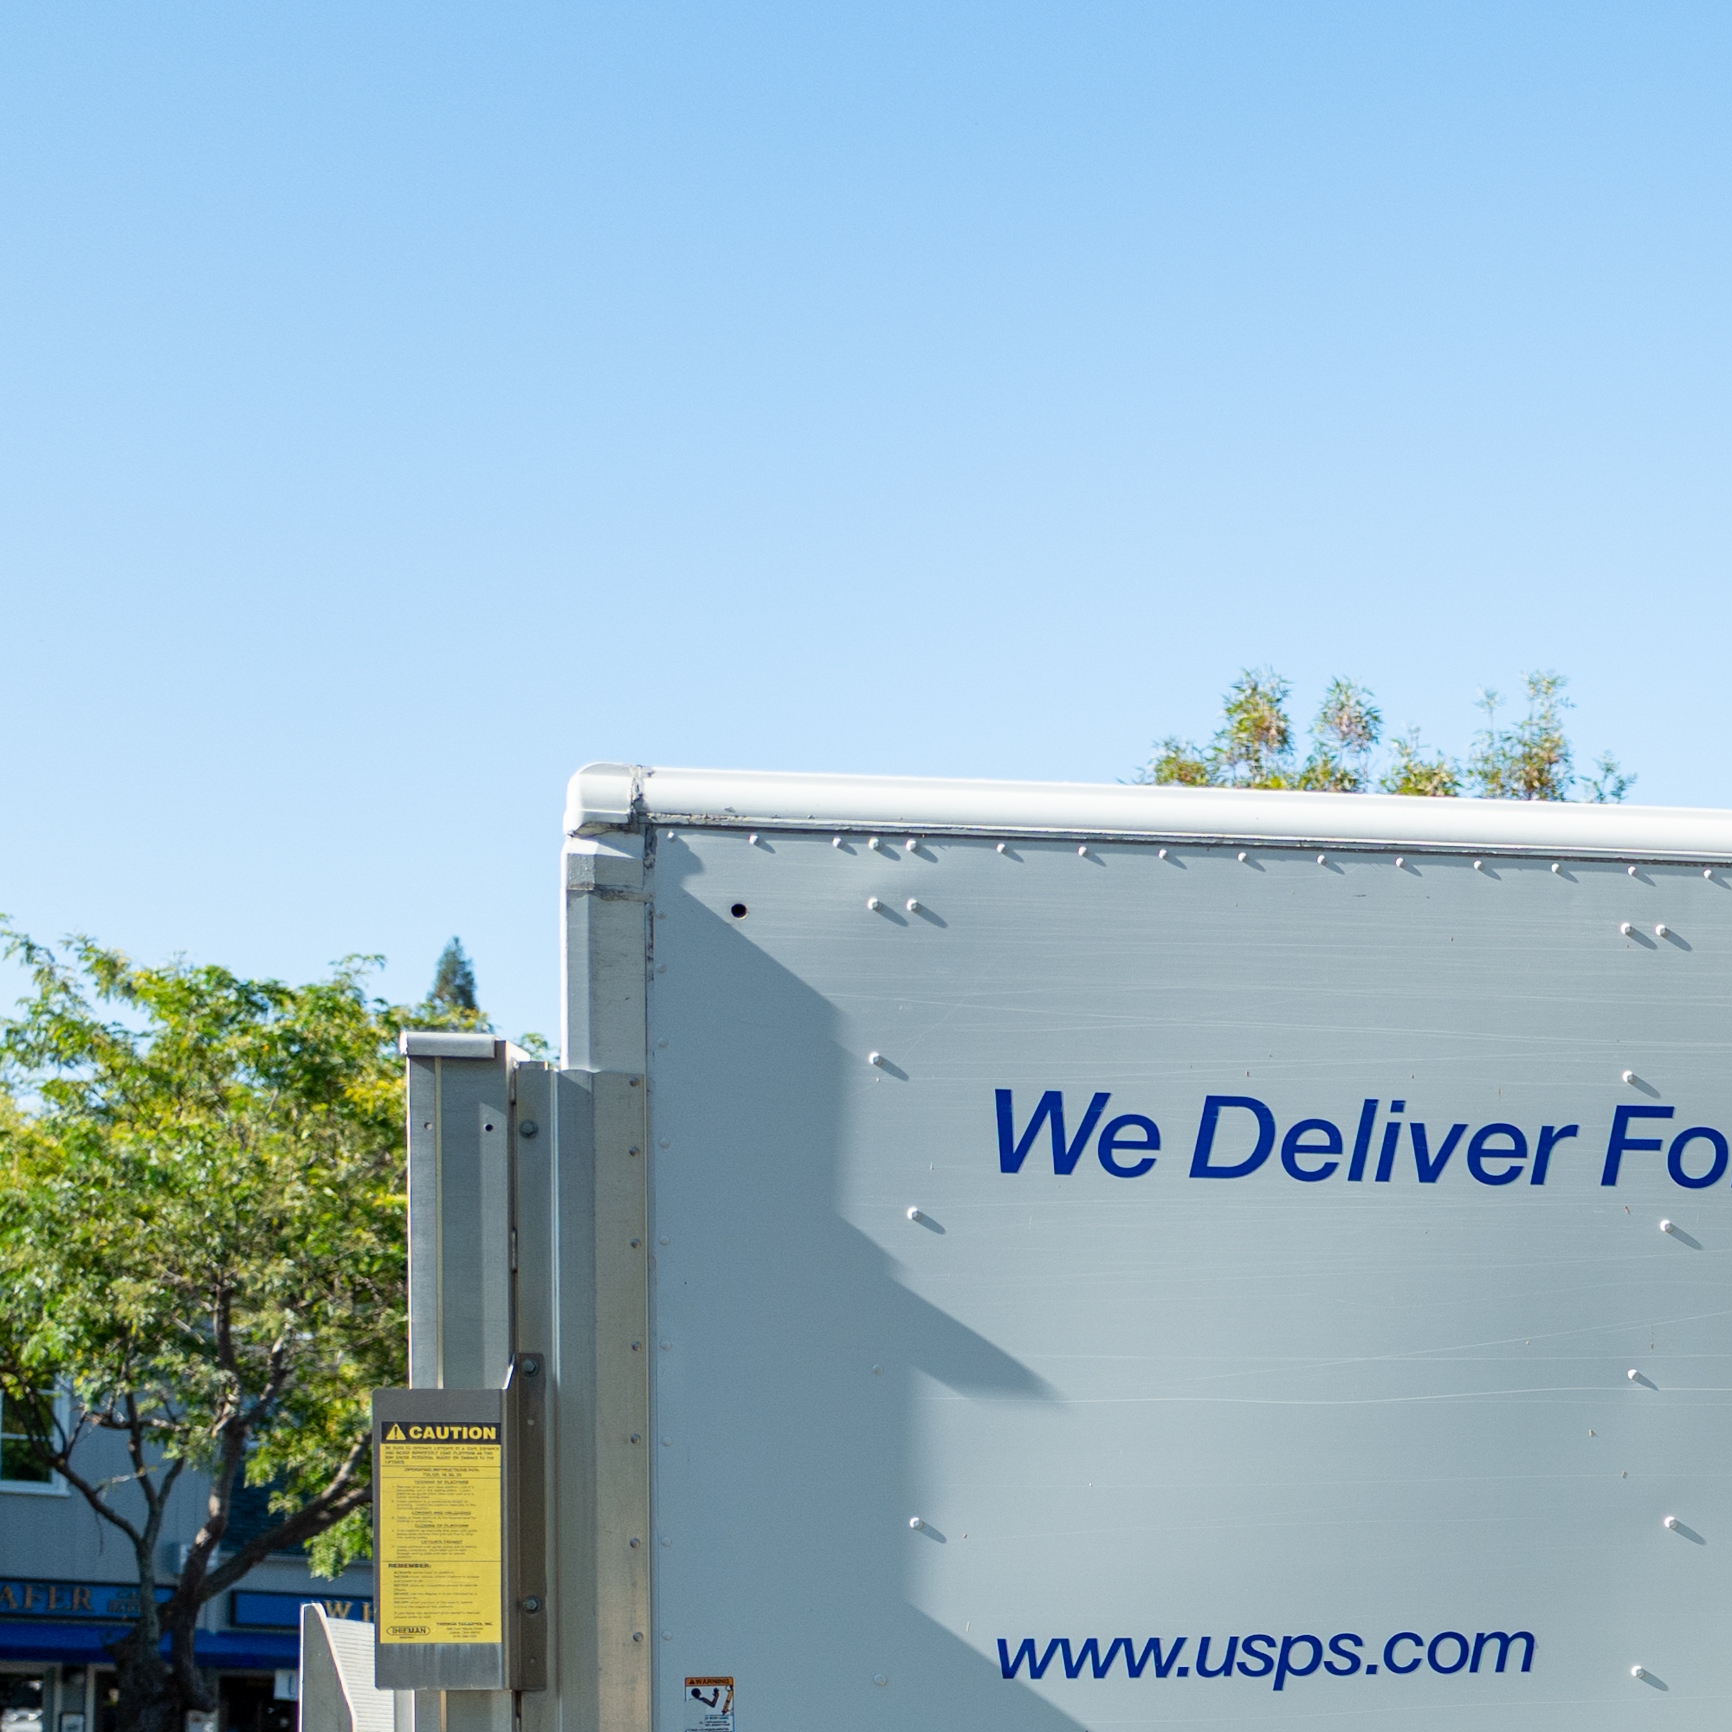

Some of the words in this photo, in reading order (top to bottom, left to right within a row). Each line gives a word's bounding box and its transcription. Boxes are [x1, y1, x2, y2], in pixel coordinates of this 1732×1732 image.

[993, 1088, 1161, 1179] We
[1188, 1095, 1579, 1187] Deliver
[409, 1425, 497, 1440] CAUTION
[996, 1630, 1536, 1691] www.usps.com
[695, 1678, 730, 1686] WARNING
